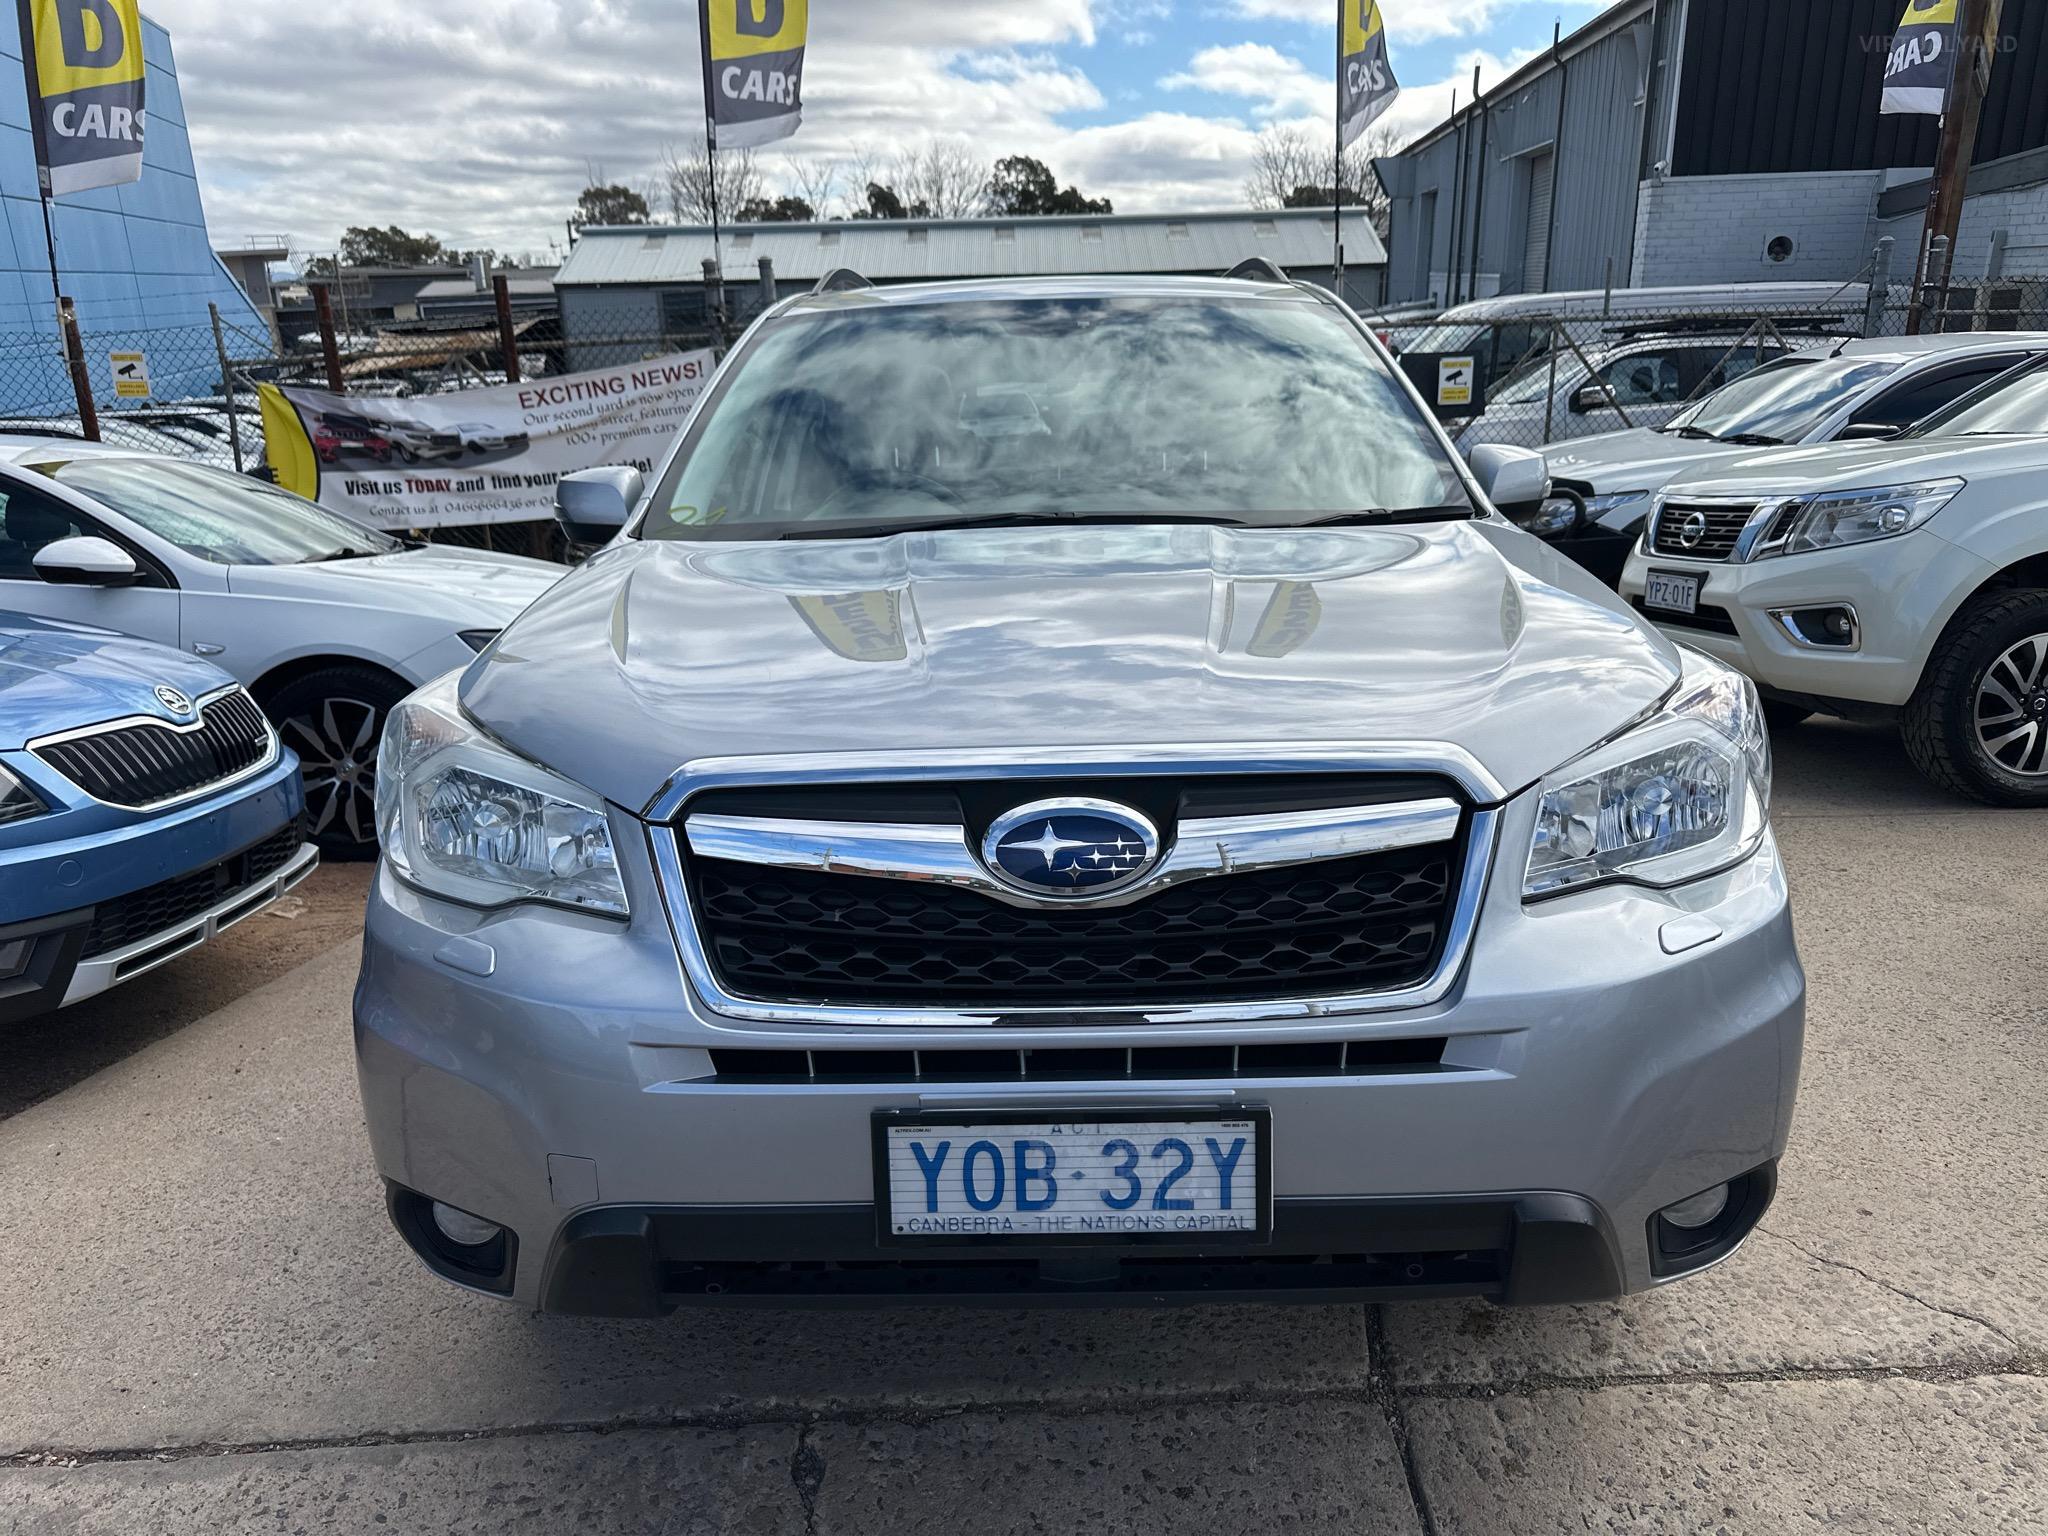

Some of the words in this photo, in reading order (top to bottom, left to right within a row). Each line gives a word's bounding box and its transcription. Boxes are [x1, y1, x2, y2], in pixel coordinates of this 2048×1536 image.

[721, 65, 797, 106] CARS
[518, 376, 625, 409] EXCITING
[631, 360, 704, 391] NEWS!
[524, 413, 549, 426] Our
[553, 403, 594, 421] second
[597, 397, 623, 418] yard
[626, 395, 637, 407] is
[640, 393, 665, 405] now
[667, 388, 695, 402] open
[601, 425, 651, 446] premium
[344, 480, 381, 496] Visit
[382, 481, 403, 494] us
[404, 478, 452, 494] TODAY
[456, 476, 485, 492] and
[491, 474, 522, 490] find
[523, 471, 558, 488] your
[369, 503, 411, 516] Contact
[414, 504, 426, 514] us
[429, 502, 438, 514] at
[525, 498, 537, 508] or
[908, 1216, 1013, 1232] CANBERRA
[1034, 1215, 1072, 1231] THE
[1081, 1215, 1165, 1230] NATION'S
[1175, 1215, 1249, 1230] CAPITAL
